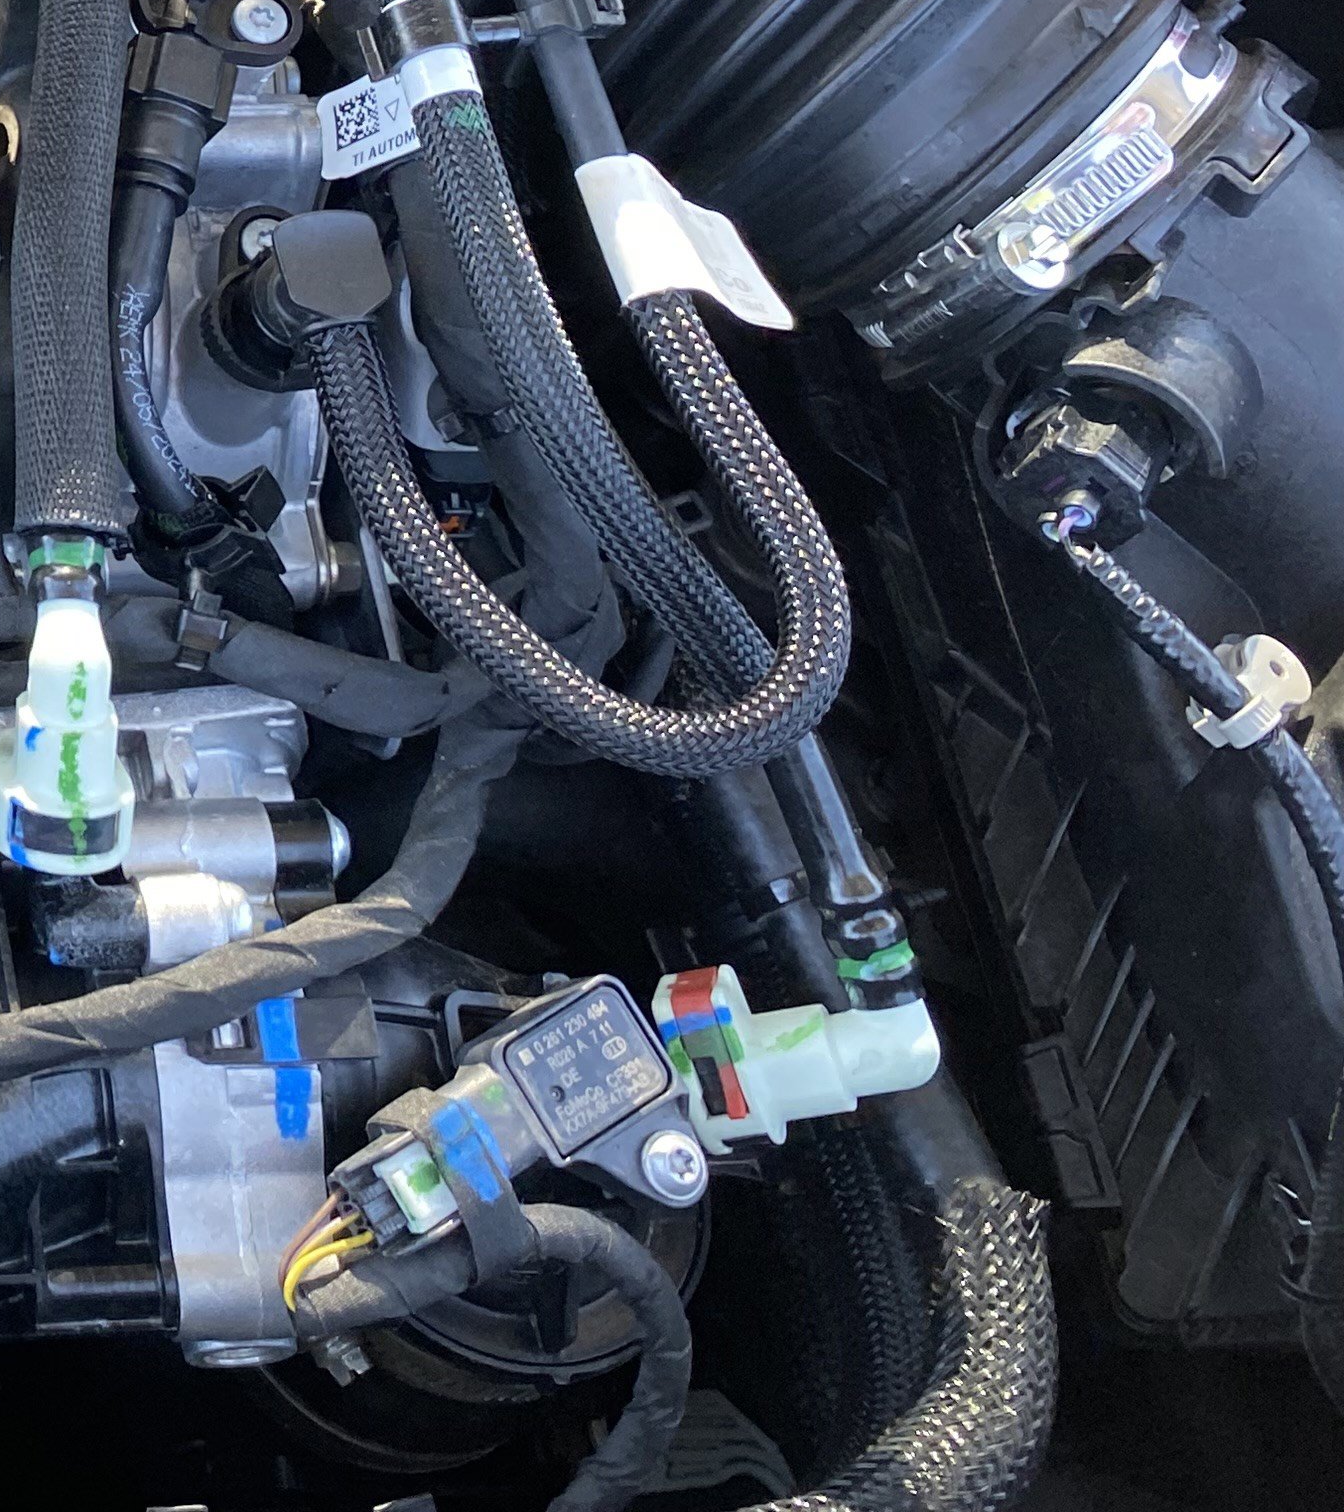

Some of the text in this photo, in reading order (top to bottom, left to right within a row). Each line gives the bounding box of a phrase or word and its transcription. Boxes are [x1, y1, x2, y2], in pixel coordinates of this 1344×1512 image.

[353, 151, 364, 167] TI
[564, 1013, 587, 1036] 230
[560, 1066, 583, 1088] DE
